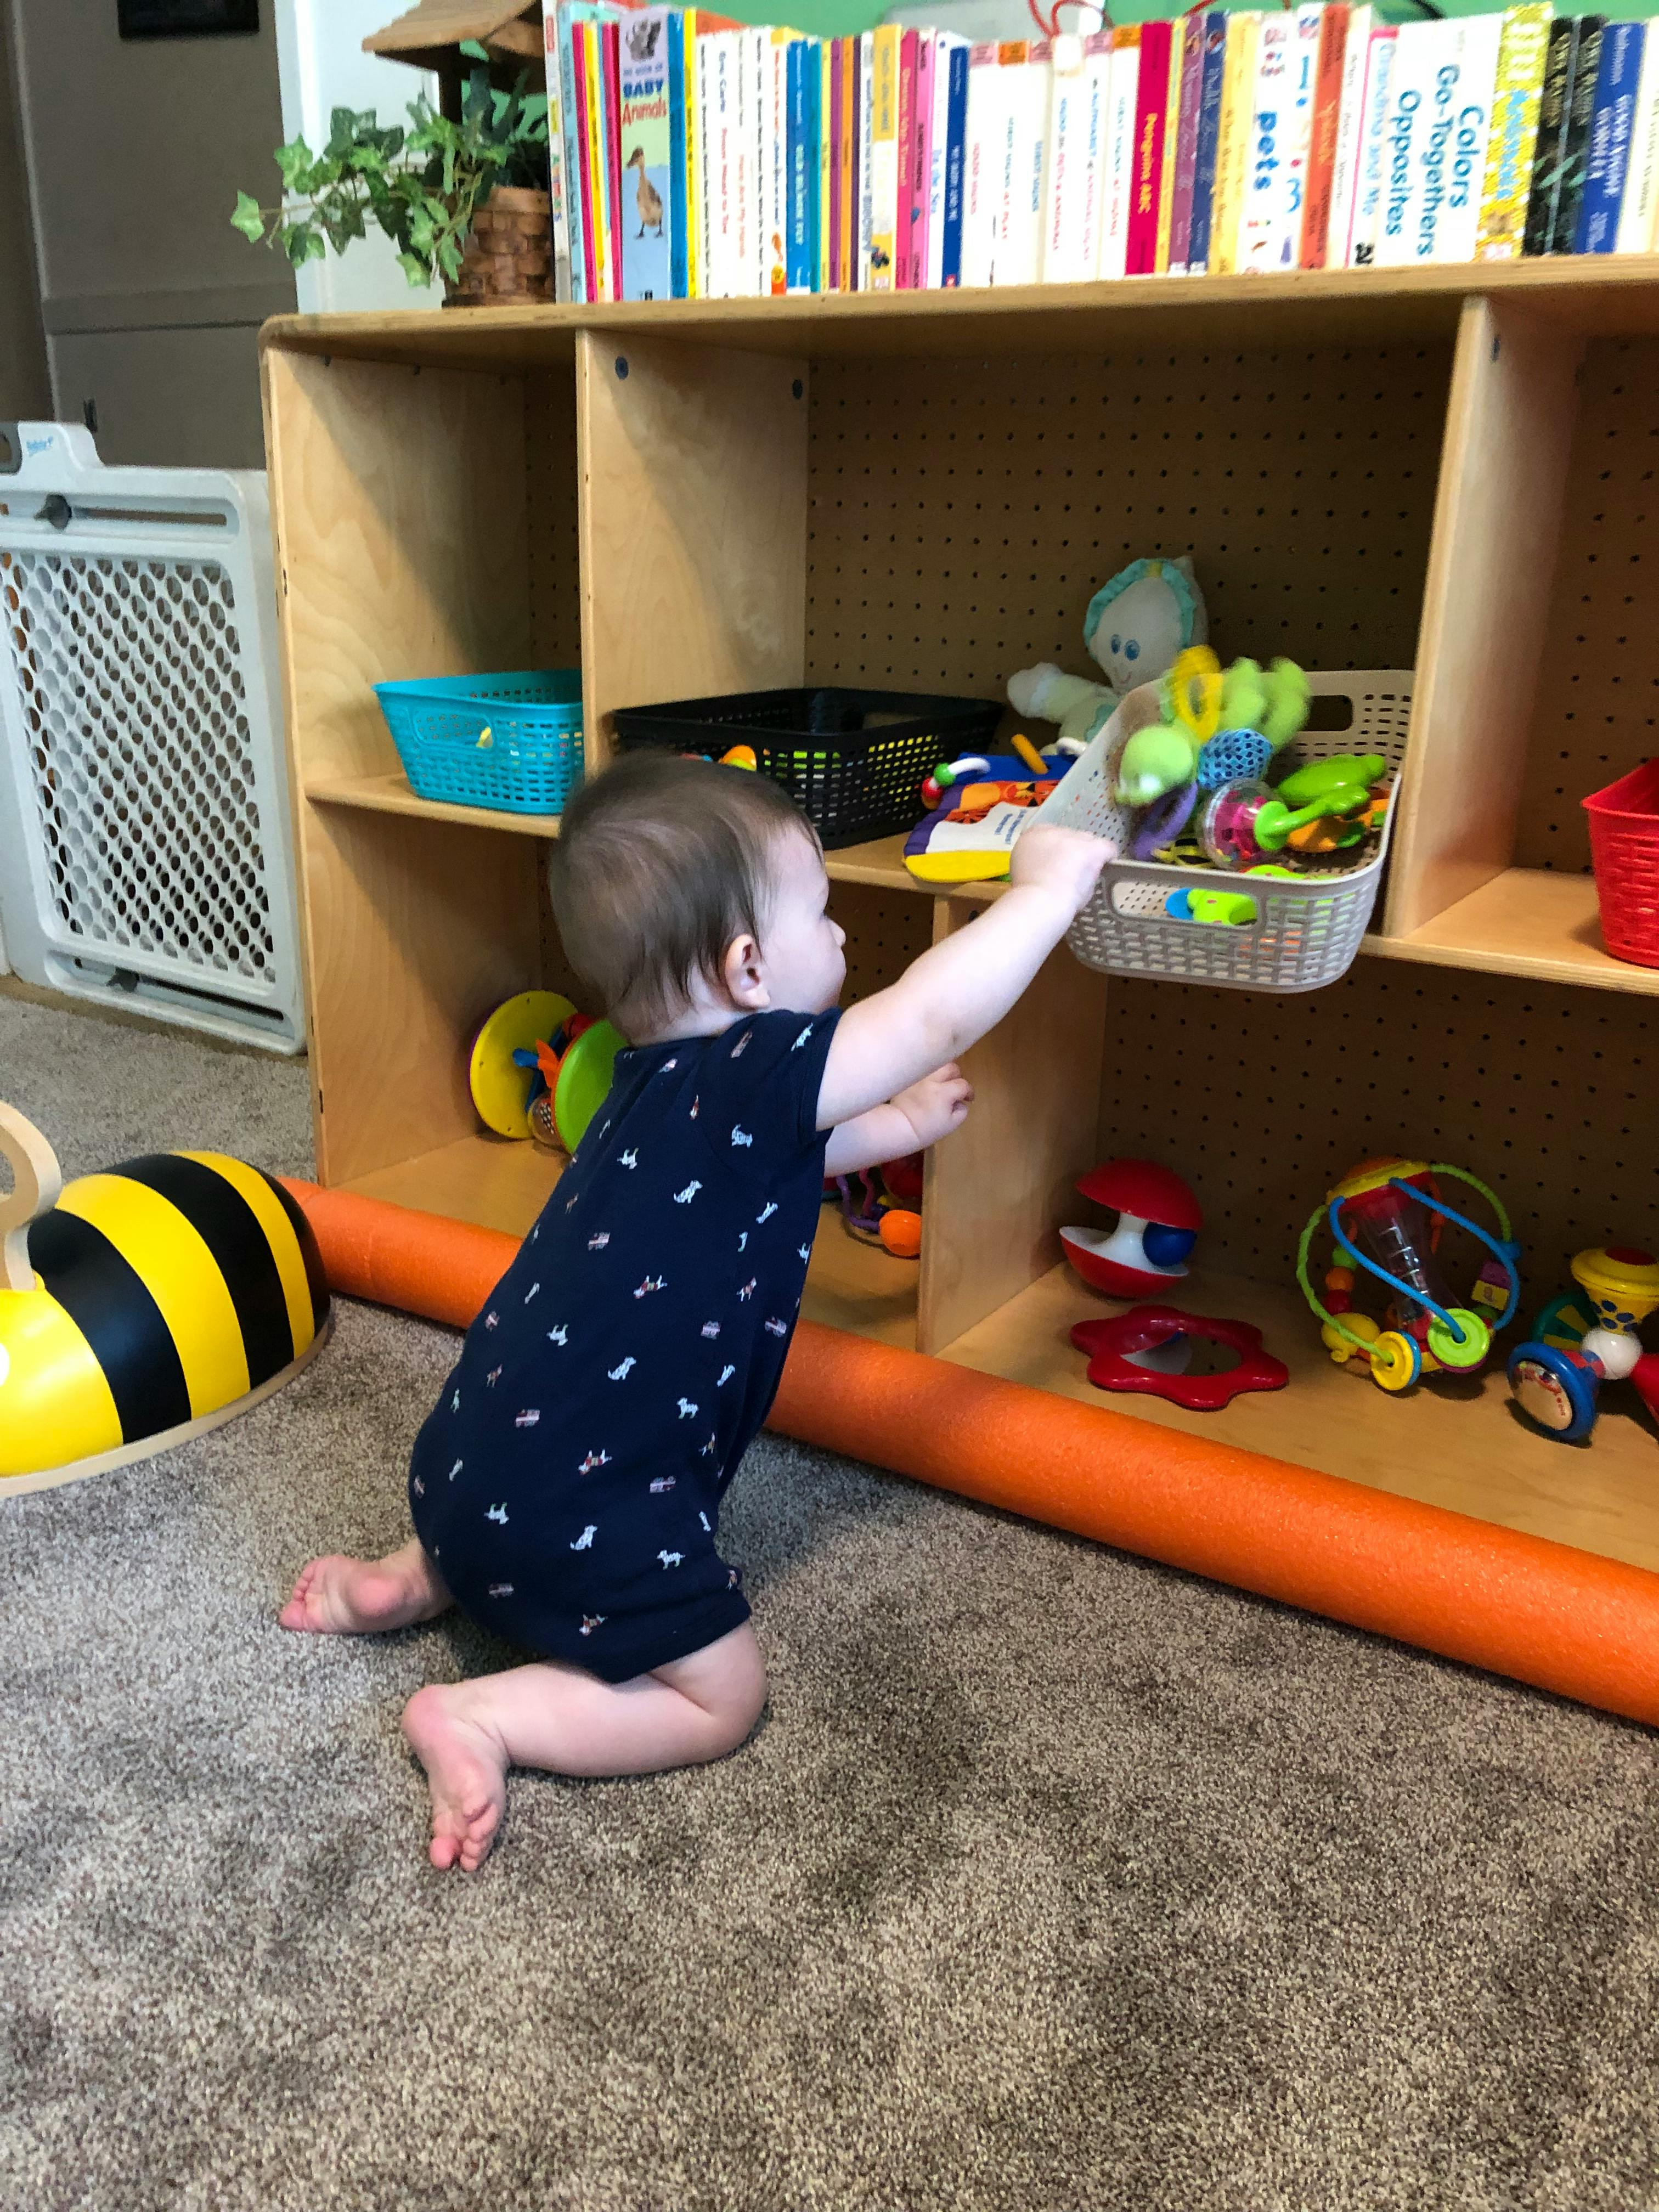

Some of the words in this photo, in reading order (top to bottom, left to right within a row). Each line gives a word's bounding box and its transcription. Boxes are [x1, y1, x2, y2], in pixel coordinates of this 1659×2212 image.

[622, 95, 667, 127] Animals
[623, 78, 664, 99] BABY
[1370, 43, 1396, 137] Grandma
[1139, 112, 1158, 182] Penguins
[1254, 111, 1280, 192] pets
[1367, 145, 1382, 180] and
[1386, 90, 1422, 236] Opposites
[1417, 64, 1461, 257] Go-Togethers
[1449, 106, 1485, 208] Colors
[1137, 183, 1152, 215] ABC
[1363, 187, 1380, 216] Me
